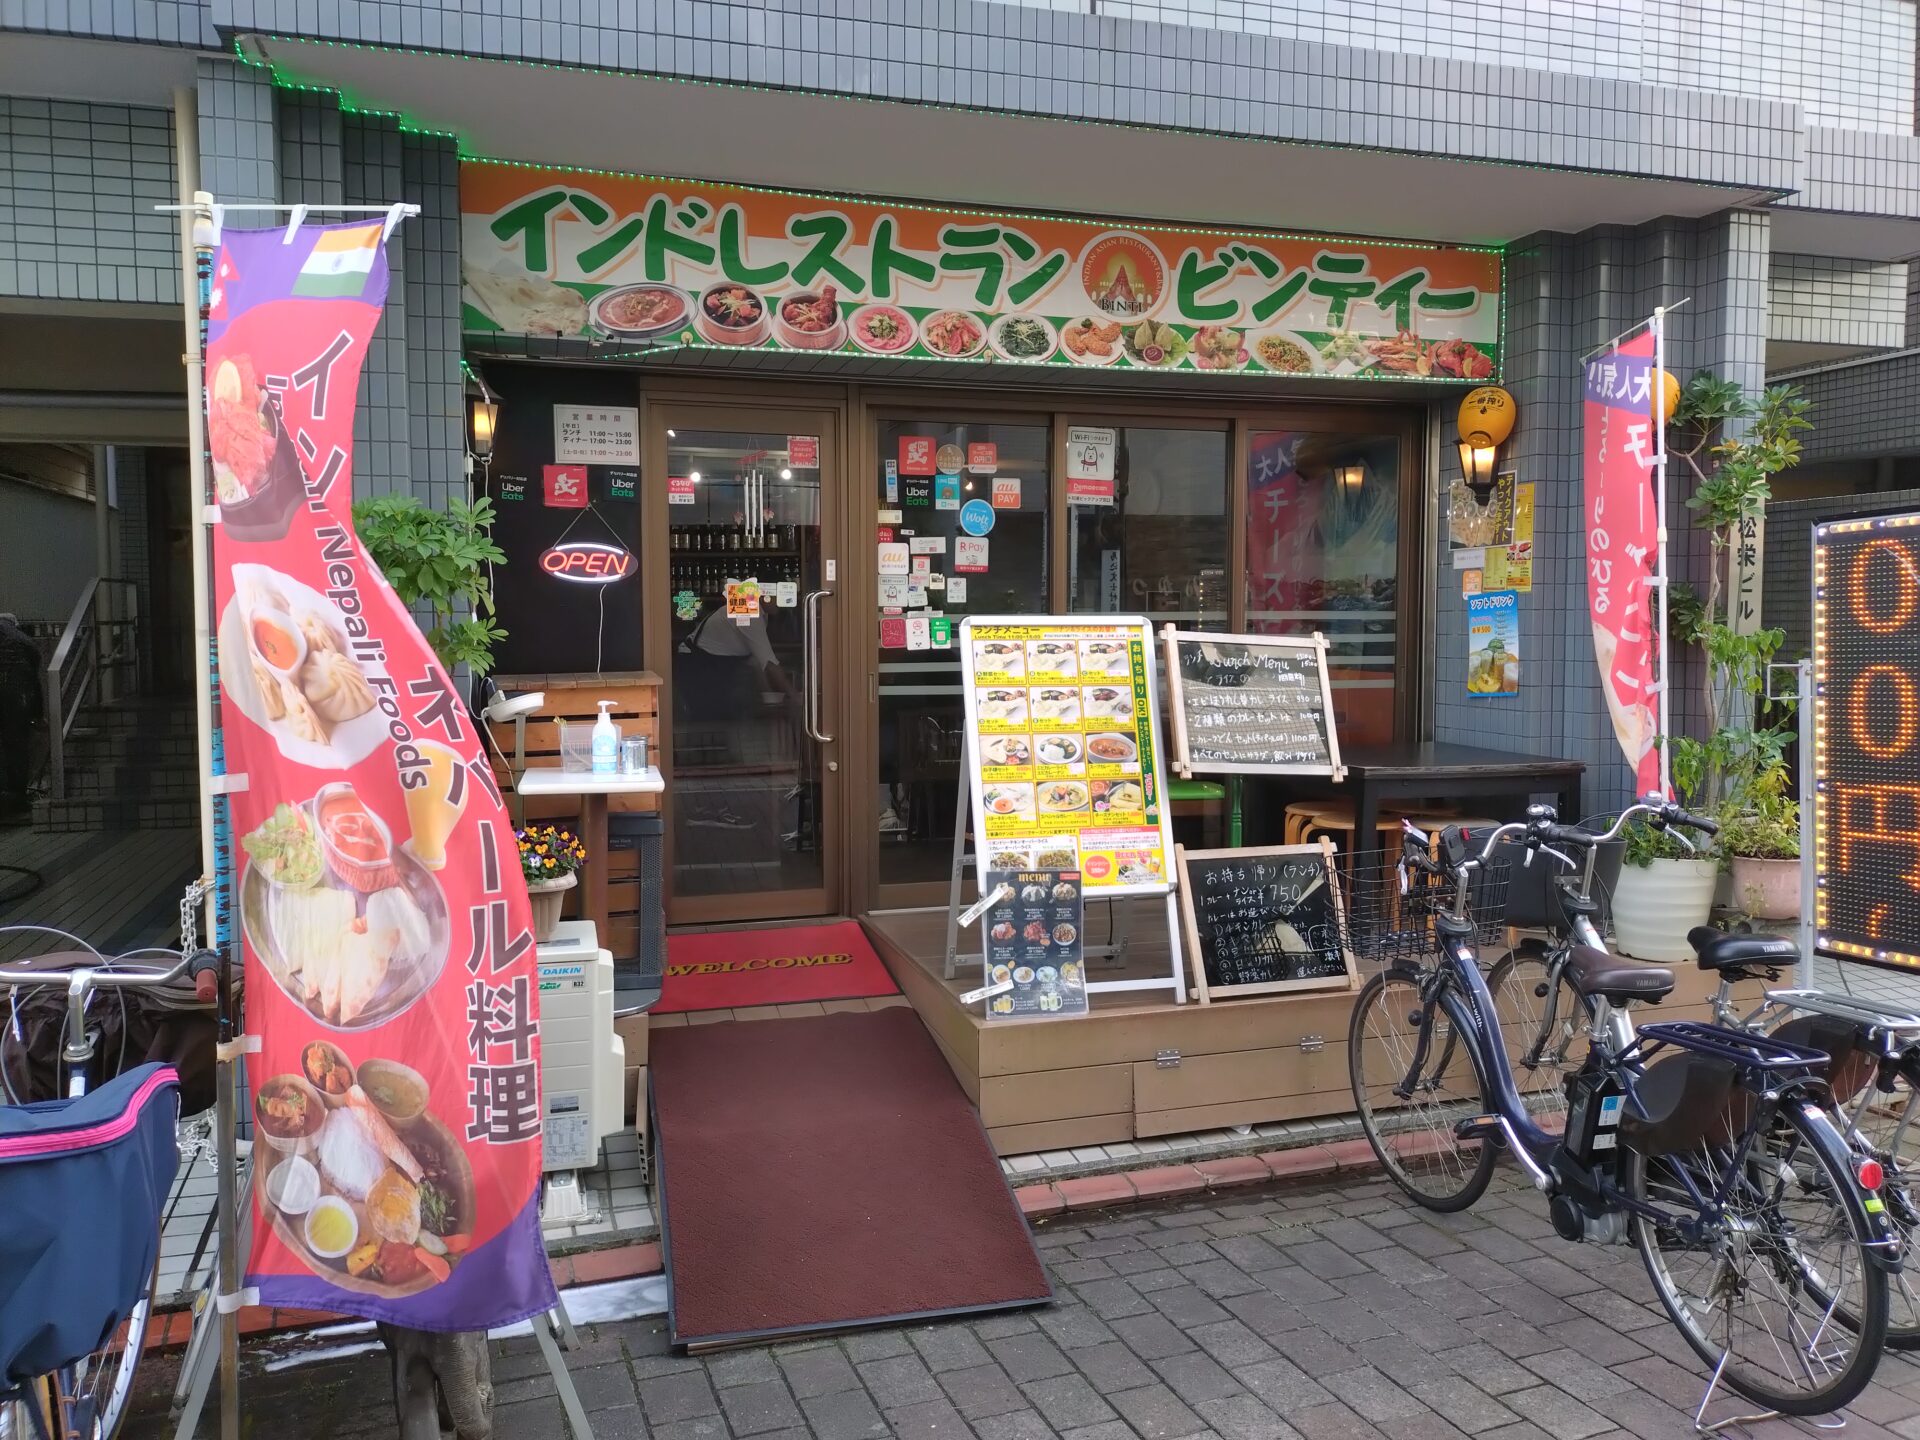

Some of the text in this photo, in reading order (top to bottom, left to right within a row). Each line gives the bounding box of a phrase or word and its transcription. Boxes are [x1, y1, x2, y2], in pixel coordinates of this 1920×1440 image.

[1083, 254, 1097, 286] INDIAN
[1096, 238, 1118, 253] ASIAN
[1177, 246, 1476, 332] ビンティー
[1101, 298, 1142, 313] BINTI
[1074, 433, 1090, 441] Wi-Fi
[501, 482, 525, 493] Uber
[611, 478, 635, 489] Uber
[996, 483, 1016, 492] au
[501, 491, 524, 501] Eats
[611, 487, 635, 498] Eats
[906, 487, 929, 496] Uber
[906, 496, 929, 506] Eats
[997, 494, 1015, 503] PAY
[1501, 474, 1513, 541] テイクアウト
[965, 511, 989, 524] Wolt
[968, 542, 985, 553] Pay
[543, 551, 629, 576] OPEN
[1470, 594, 1515, 610] ソフトドリンク
[728, 606, 759, 614] メニュー
[974, 625, 1041, 635] ランチメニュー
[315, 522, 387, 664] Nepali
[367, 676, 432, 791] Foods
[1253, 653, 1290, 674] Menu
[1018, 872, 1051, 882] menu
[1762, 944, 1786, 953] YAMAHA
[666, 952, 854, 977] WELCOME
[543, 966, 582, 975] DAIKIN
[1635, 978, 1660, 987] YAMAHA
